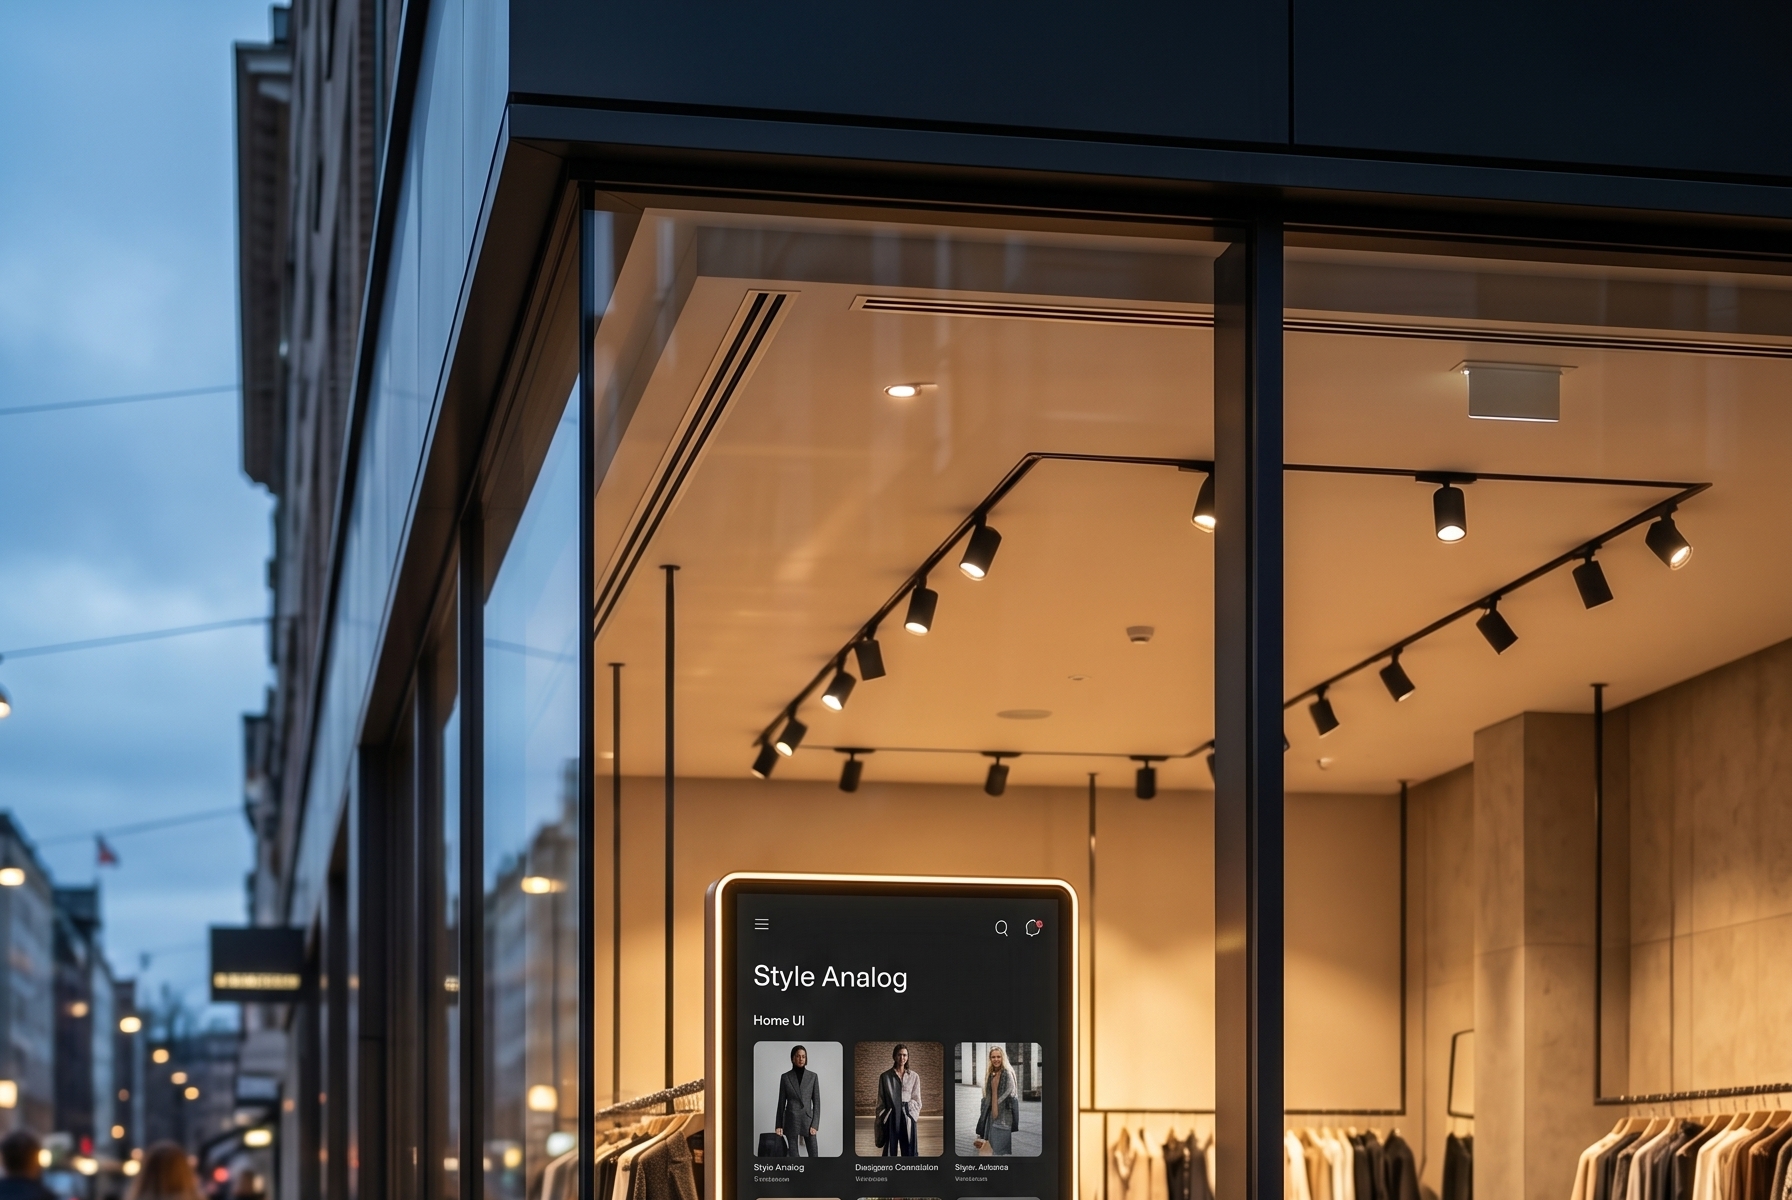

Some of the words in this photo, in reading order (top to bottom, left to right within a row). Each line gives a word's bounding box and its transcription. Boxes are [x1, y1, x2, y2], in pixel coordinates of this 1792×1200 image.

[753, 963, 816, 992] Style
[822, 965, 908, 993] Analog
[753, 1014, 790, 1027] Home
[792, 1014, 805, 1027] UI
